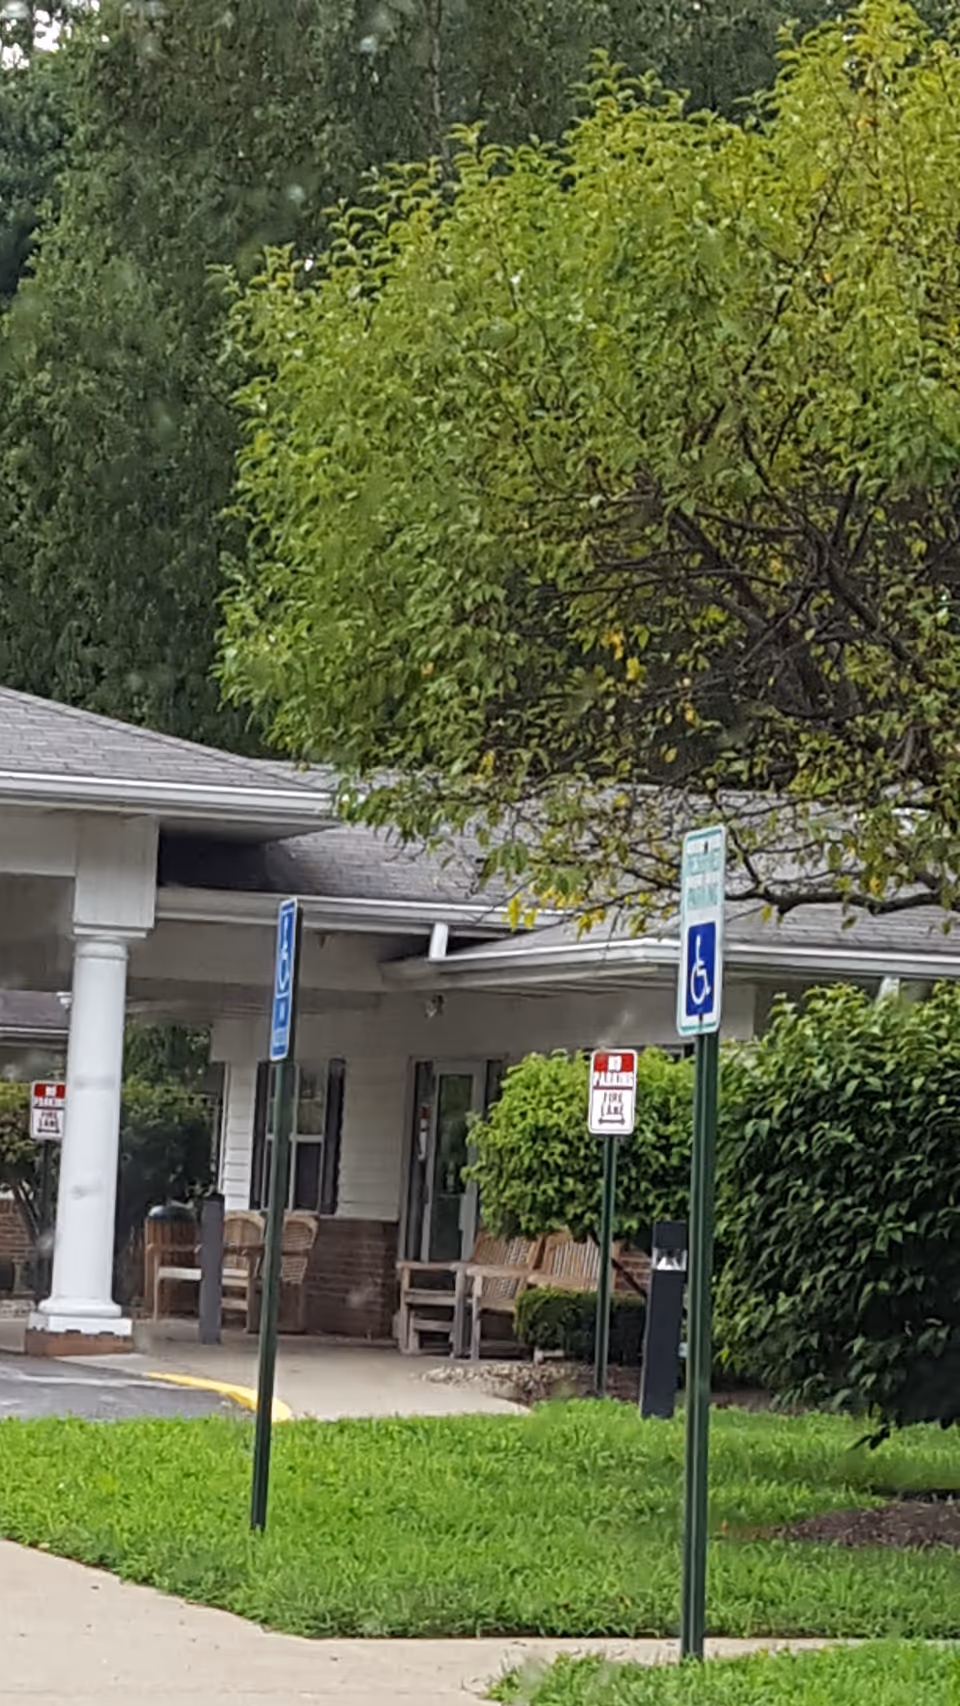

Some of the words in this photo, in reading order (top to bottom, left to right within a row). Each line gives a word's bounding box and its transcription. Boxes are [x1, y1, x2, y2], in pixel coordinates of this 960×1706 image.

[594, 1071, 634, 1087] PARKING
[603, 1091, 623, 1104] FIRE
[601, 1104, 623, 1117] LANE
